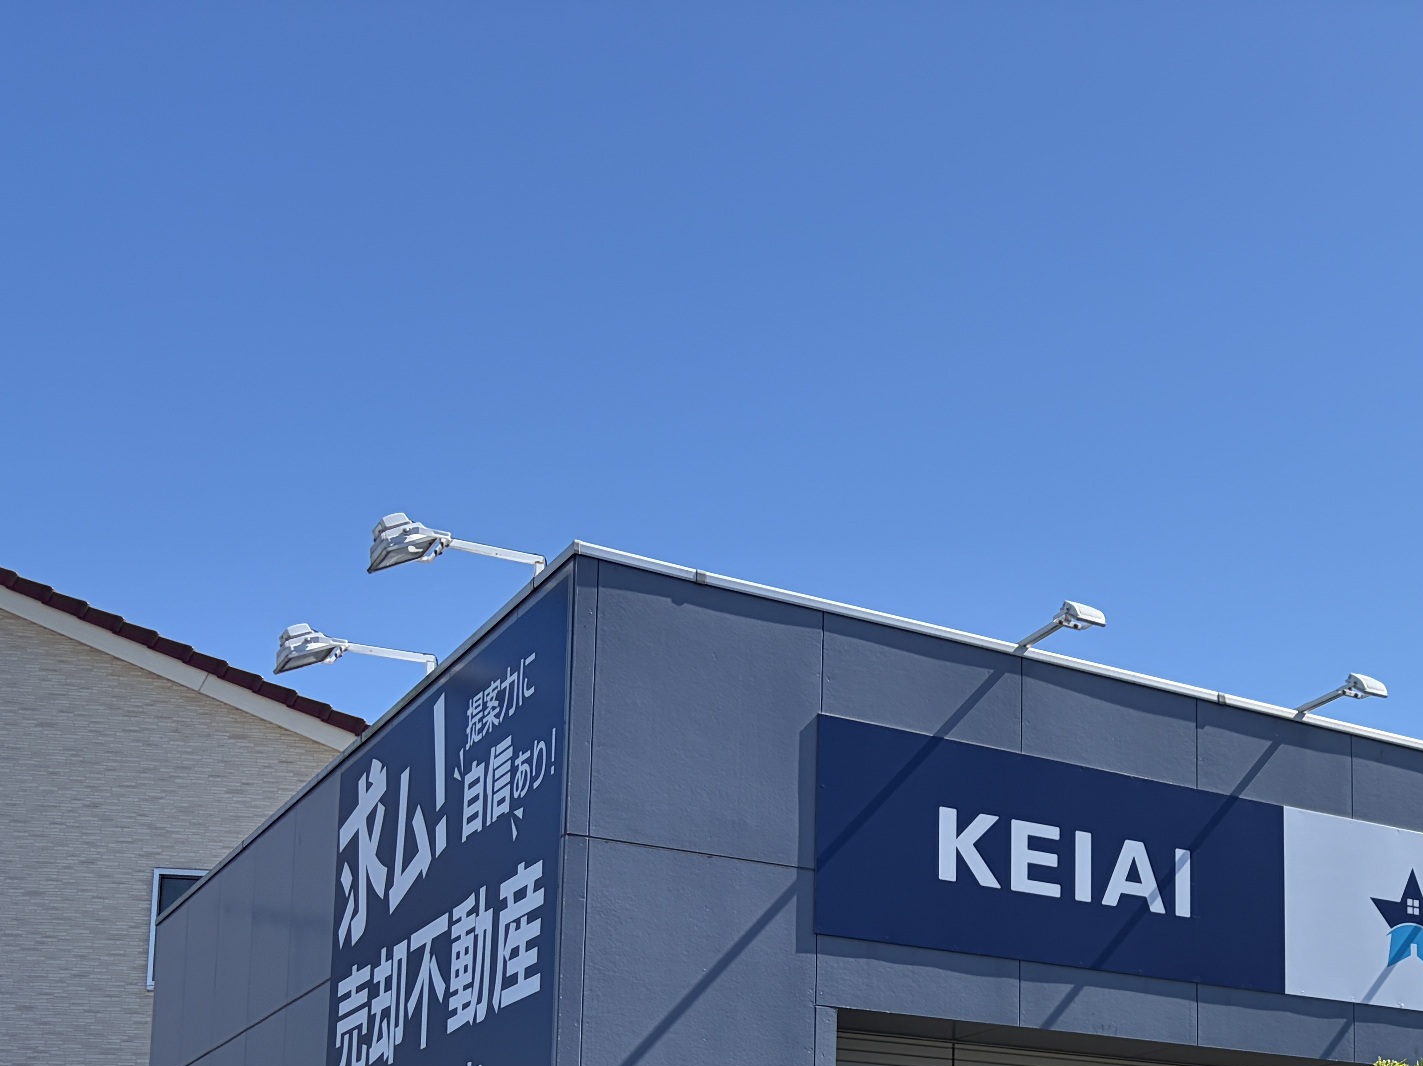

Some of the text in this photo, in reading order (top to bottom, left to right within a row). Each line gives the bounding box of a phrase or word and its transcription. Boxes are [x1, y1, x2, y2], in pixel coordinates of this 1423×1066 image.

[465, 652, 536, 751] 提案力に
[338, 691, 447, 950] 求ム!
[461, 727, 557, 843] 自信あり!
[938, 806, 1191, 918] KEIAI
